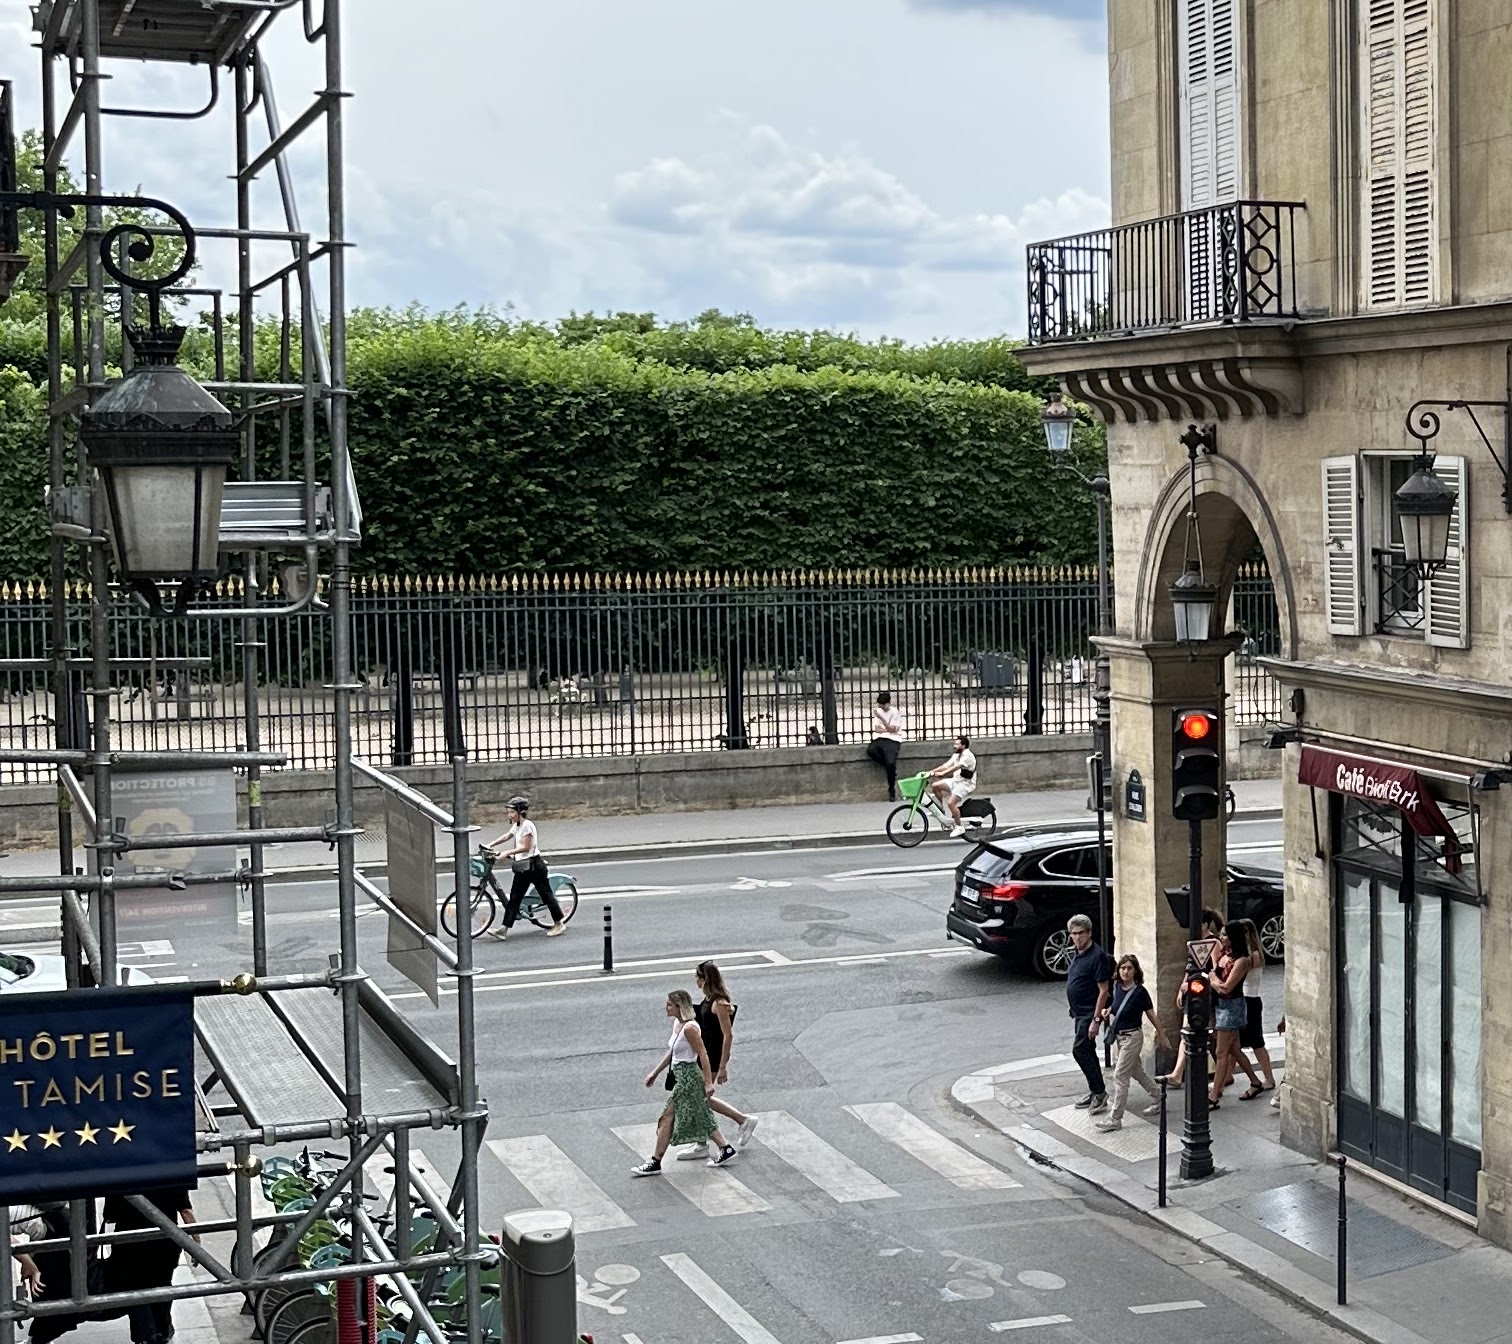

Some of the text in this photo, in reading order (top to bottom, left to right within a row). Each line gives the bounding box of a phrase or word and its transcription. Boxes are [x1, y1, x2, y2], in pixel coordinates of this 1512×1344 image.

[1337, 763, 1365, 794] Café
[0, 1031, 135, 1064] HÔTEL
[13, 1068, 182, 1108] TAMISE
